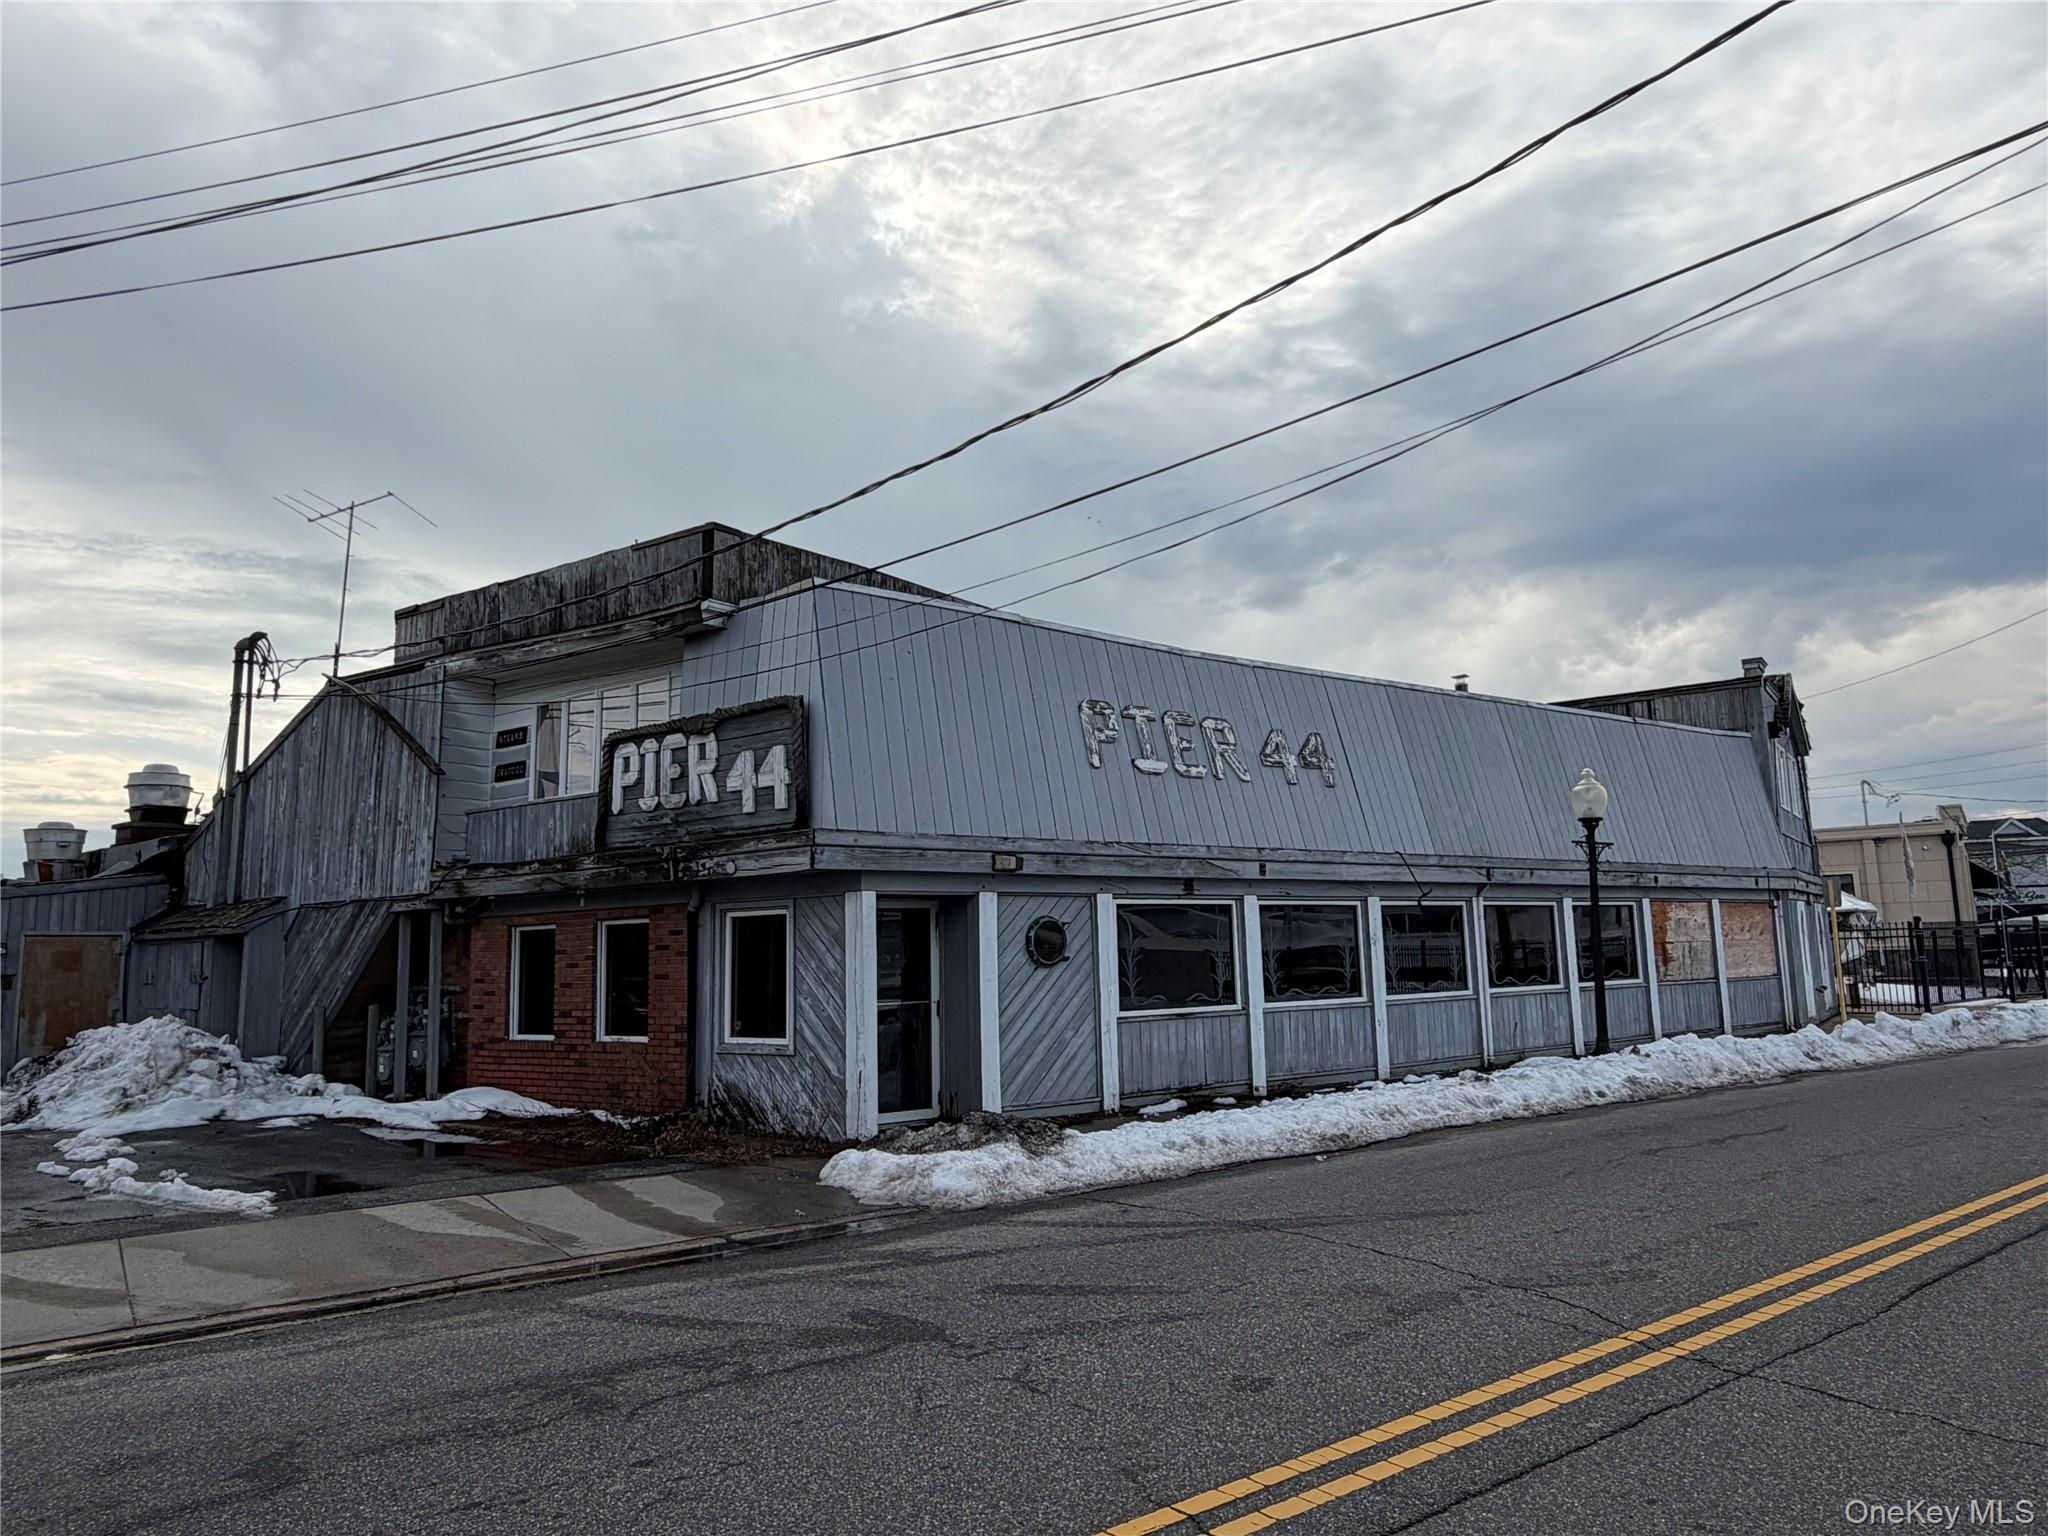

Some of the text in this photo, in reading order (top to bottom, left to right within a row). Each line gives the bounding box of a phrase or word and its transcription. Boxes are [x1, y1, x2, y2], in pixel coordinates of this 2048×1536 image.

[611, 732, 792, 815] PIER 44
[1079, 698, 1335, 787] PIER 44
